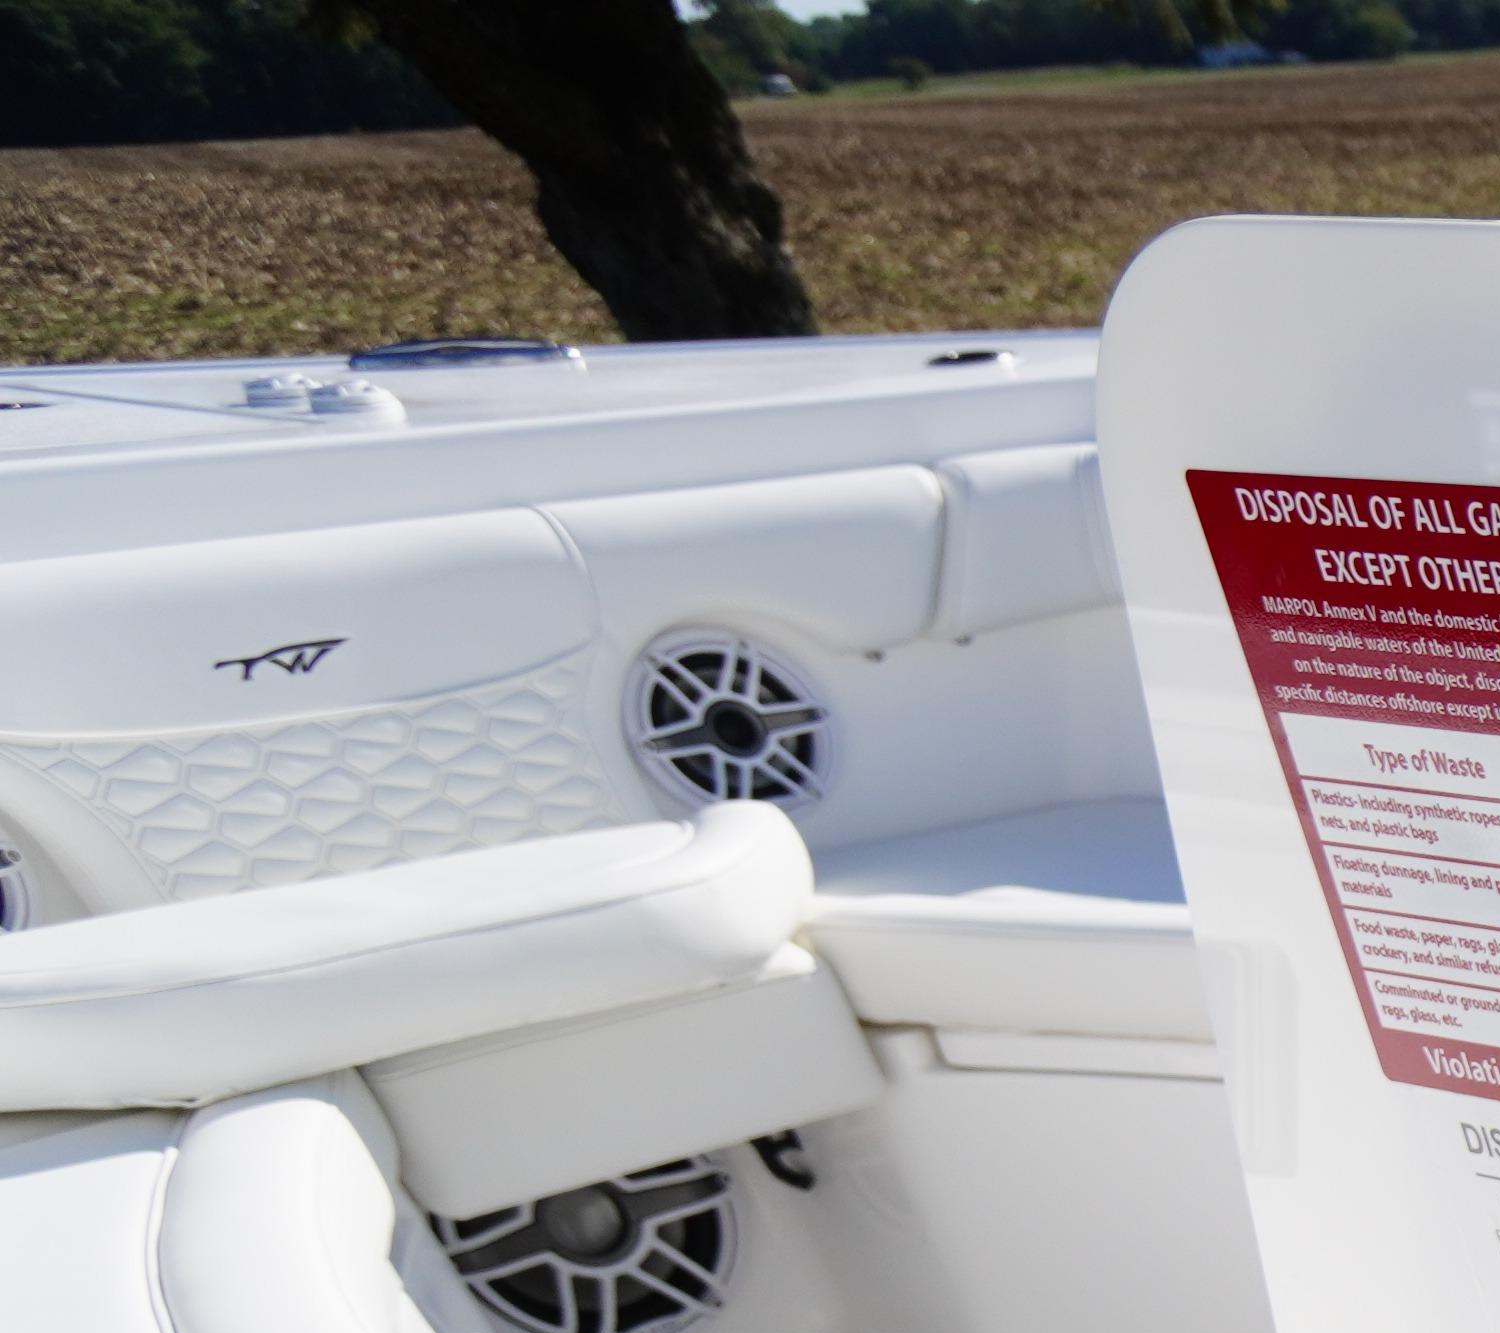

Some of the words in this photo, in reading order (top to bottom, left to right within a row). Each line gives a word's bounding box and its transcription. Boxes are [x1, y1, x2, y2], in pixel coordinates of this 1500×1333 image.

[1234, 487, 1369, 529] DISPOSAL
[1368, 495, 1406, 531] OF
[1412, 497, 1467, 535] ALL
[1314, 548, 1413, 588] EXCEPT
[1261, 595, 1323, 618] MARPOL
[1322, 600, 1368, 621] Annex
[1364, 603, 1377, 622] V
[1379, 606, 1408, 625] and
[1406, 607, 1434, 628] the
[1433, 610, 1500, 633] domestic
[1269, 625, 1298, 644] and
[1296, 628, 1365, 652] navigable
[1363, 636, 1412, 655] waters
[1411, 636, 1428, 656] of
[1427, 638, 1455, 659] the
[1293, 658, 1314, 673] on
[1311, 656, 1337, 676] the
[1336, 663, 1384, 681] nature
[1382, 662, 1399, 682] of
[1398, 664, 1425, 685] the
[1424, 667, 1475, 692] object,
[1274, 682, 1325, 703] specific
[1324, 686, 1388, 710] distances
[1387, 692, 1446, 715] offshore
[1445, 702, 1495, 722] except
[1362, 742, 1410, 774] Type
[1410, 748, 1430, 773] of
[1428, 750, 1487, 780] Waste
[1319, 815, 1349, 831] nets,
[1347, 818, 1372, 833] and
[1371, 819, 1411, 839] plastic
[1408, 824, 1440, 845] bags
[1413, 804, 1469, 824] synthetic
[1332, 853, 1381, 878] Floating
[1380, 863, 1435, 885] dunnage,
[1433, 867, 1471, 891] lining
[1469, 876, 1494, 891] and
[1340, 880, 1394, 899] materials
[1352, 917, 1384, 936] Food
[1383, 925, 1420, 942] waste,
[1420, 931, 1458, 949] paper,
[1456, 936, 1487, 954] rags,
[1362, 943, 1413, 964] crockery,
[1411, 951, 1436, 966] and
[1434, 952, 1474, 972] similar
[1373, 979, 1446, 1004] Comminuted
[1445, 994, 1459, 1006] or
